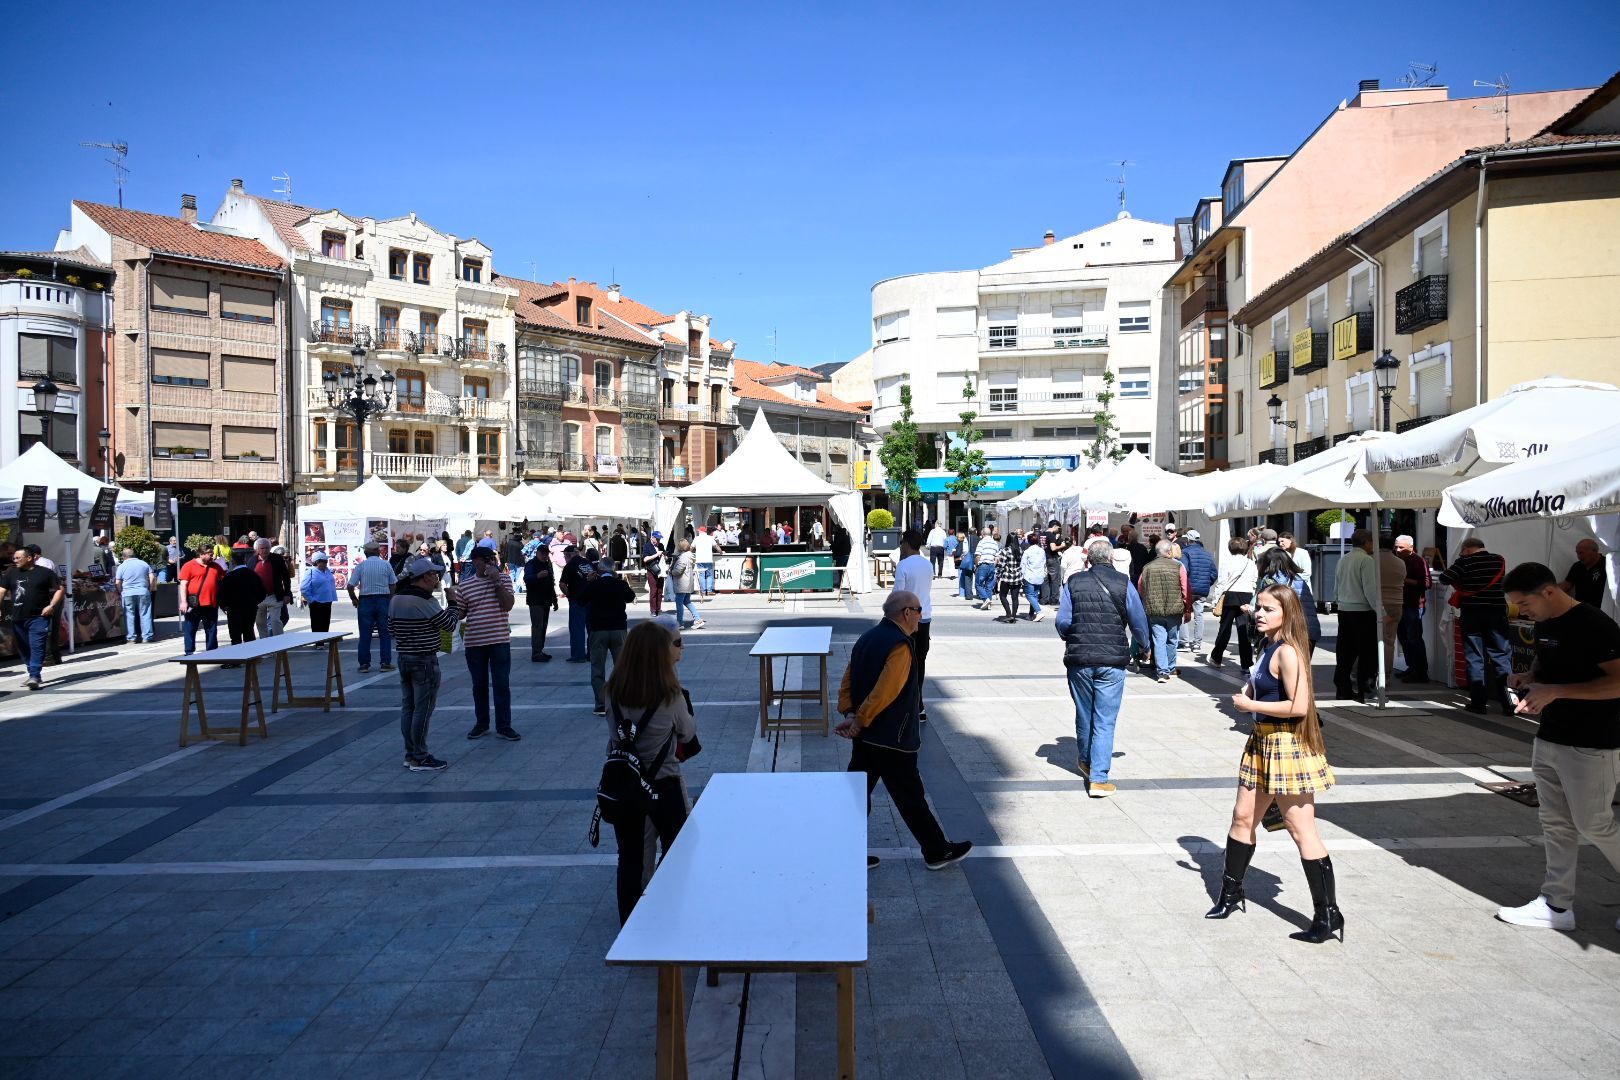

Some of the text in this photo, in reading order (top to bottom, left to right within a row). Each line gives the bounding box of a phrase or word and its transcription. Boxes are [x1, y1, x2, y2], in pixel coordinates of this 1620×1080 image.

[1338, 318, 1353, 352] LUZ
[1262, 353, 1273, 380] LUZ
[1421, 453, 1440, 466] PRISA
[1480, 490, 1566, 522] Alhambra
